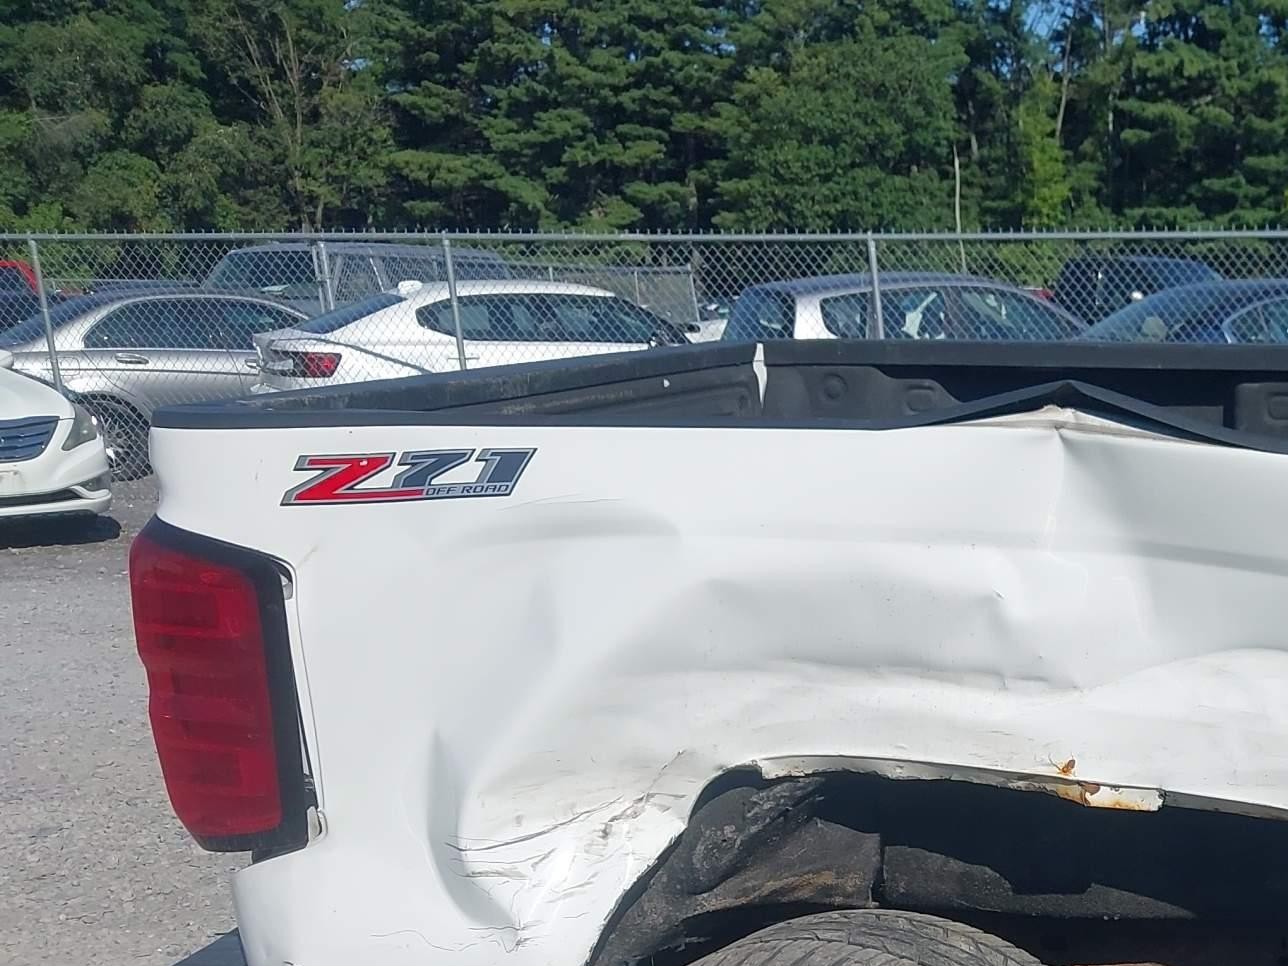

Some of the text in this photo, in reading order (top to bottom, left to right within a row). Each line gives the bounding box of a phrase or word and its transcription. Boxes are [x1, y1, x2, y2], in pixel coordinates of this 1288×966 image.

[280, 447, 538, 507] Z71
[425, 484, 510, 496] OFF ROAD
